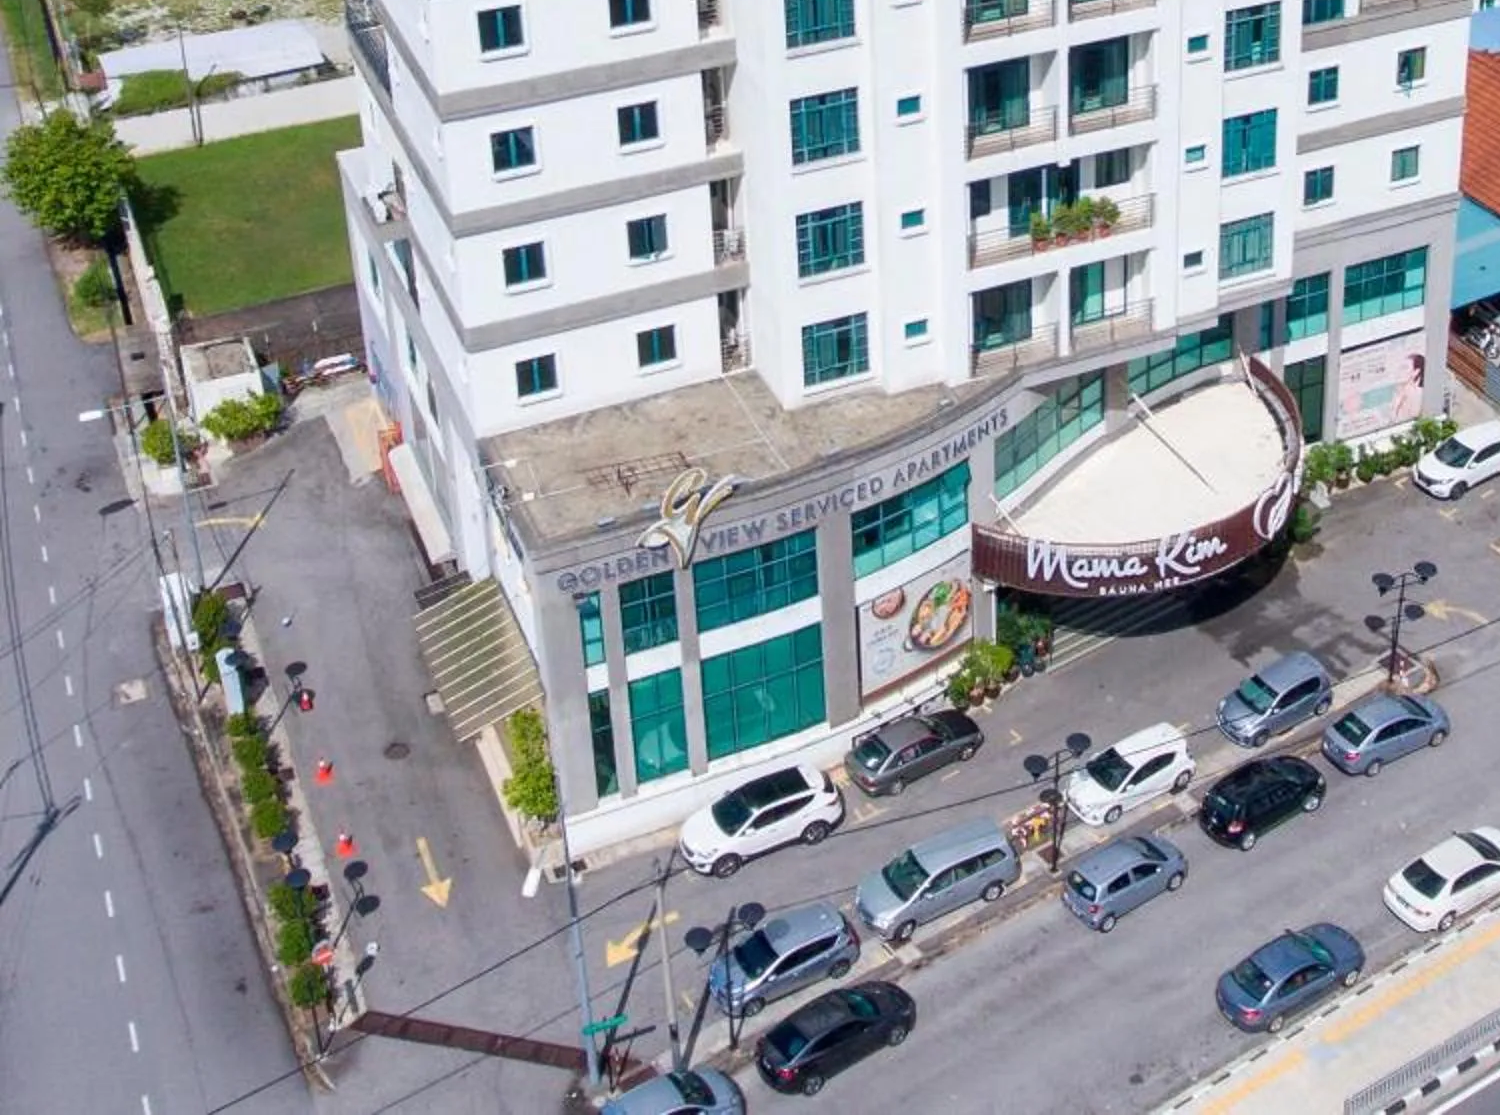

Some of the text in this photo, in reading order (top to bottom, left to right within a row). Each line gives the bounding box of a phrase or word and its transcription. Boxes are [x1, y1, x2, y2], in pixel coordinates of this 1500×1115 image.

[557, 408, 1008, 593] GOLDEN VIEW SERVICED APARTMENTS
[1027, 532, 1228, 588] Mama Kim
